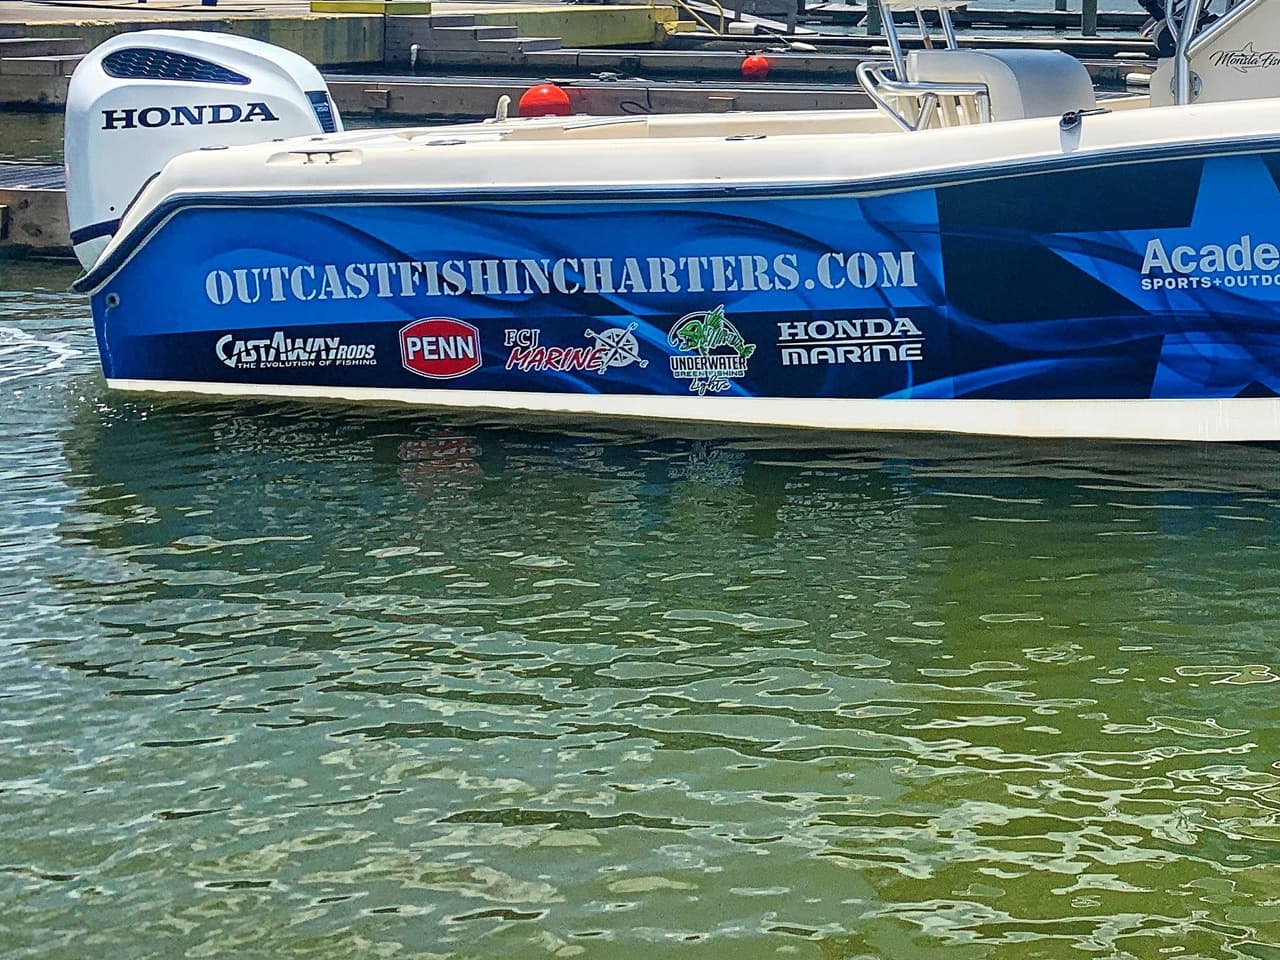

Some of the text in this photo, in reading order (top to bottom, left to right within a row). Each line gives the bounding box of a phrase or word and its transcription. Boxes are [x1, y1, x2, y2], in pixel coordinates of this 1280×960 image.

[101, 102, 280, 130] HONDA
[205, 250, 919, 305] OUTCASTFISHINCHARTERS.COM
[504, 328, 541, 350] FCJ
[777, 317, 922, 340] HONDA
[407, 335, 476, 361] PENN
[505, 345, 611, 373] MARINE
[781, 344, 924, 366] MARINE
[259, 360, 316, 368] EVOLUTION
[319, 359, 333, 367] OF
[336, 359, 378, 367] FISHING
[670, 355, 748, 371] UNDERWATER
[673, 370, 745, 378] GREEN FISHING
